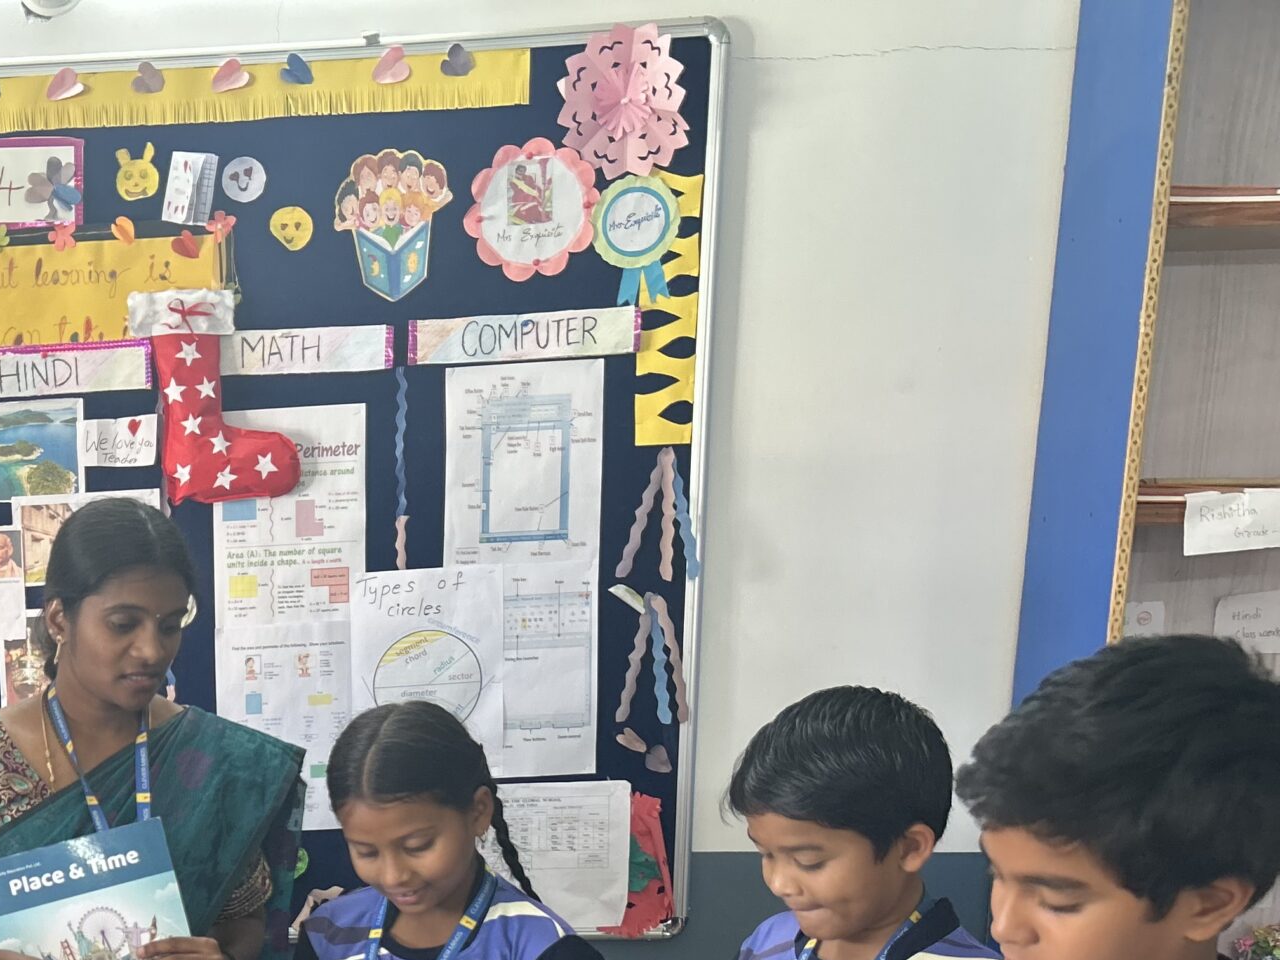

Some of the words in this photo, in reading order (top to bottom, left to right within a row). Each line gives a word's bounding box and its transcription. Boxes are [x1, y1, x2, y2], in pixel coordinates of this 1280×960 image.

[32, 257, 131, 298] learning
[144, 254, 177, 284] is
[462, 318, 598, 357] COMPUTER
[240, 333, 320, 368] MATH
[85, 430, 108, 453] We
[112, 430, 136, 451] love
[138, 436, 154, 456] you
[264, 548, 277, 558] The
[278, 547, 306, 556] number
[308, 546, 316, 555] of
[356, 577, 415, 610] Types
[438, 571, 467, 591] of
[387, 597, 442, 616] circles
[395, 637, 429, 657] segment
[405, 649, 428, 665] chord
[448, 672, 473, 681] sector
[401, 689, 438, 698] diameter
[9, 869, 65, 896] Place
[69, 863, 85, 880] &
[87, 850, 140, 875] Time
